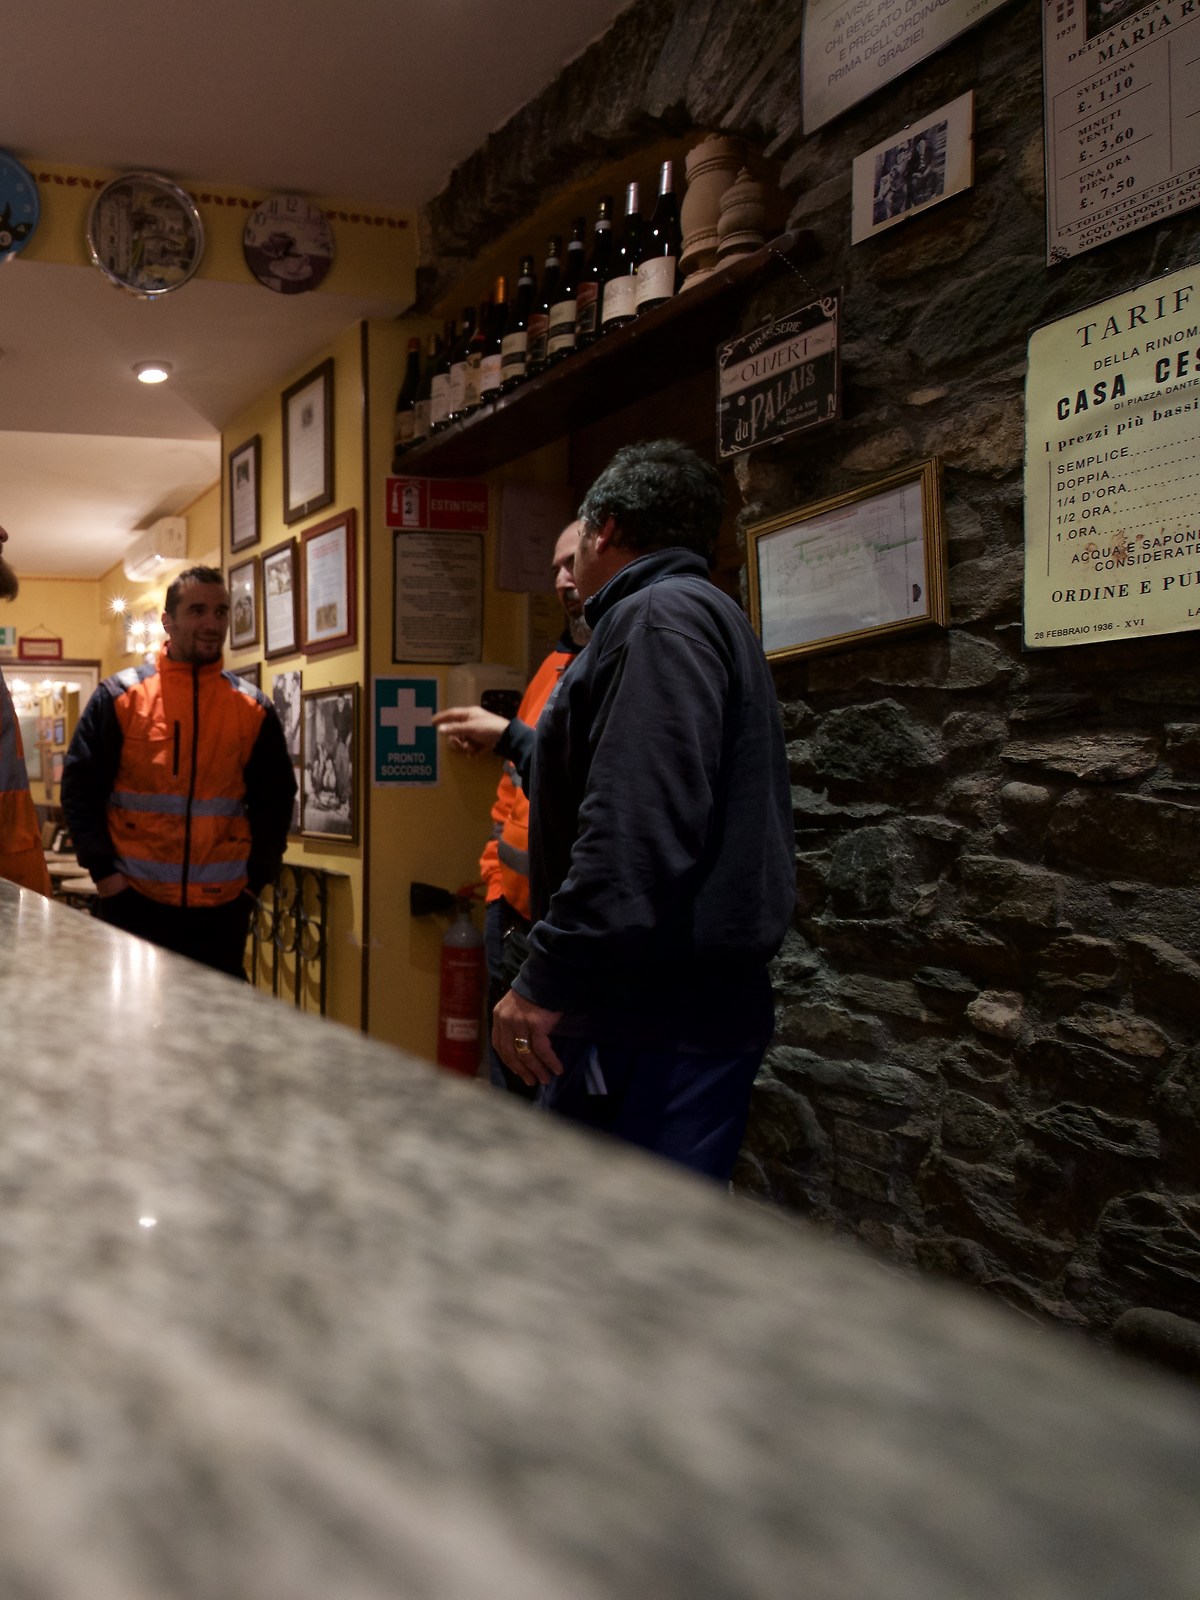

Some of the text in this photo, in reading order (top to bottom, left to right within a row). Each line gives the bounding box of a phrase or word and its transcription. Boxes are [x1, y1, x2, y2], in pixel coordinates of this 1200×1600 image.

[826, 33, 844, 54] CHI
[846, 10, 875, 38] BEVE
[840, 48, 847, 60] E
[849, 8, 901, 54] PREGATO
[878, 27, 924, 67] GRAZIE!
[1068, 4, 1161, 62] DELLA CASA
[1098, 14, 1171, 65] MARIA
[828, 56, 861, 86] PRIMA
[1077, 62, 1135, 98] SVELTINA
[1100, 76, 1133, 103] 1,10
[1078, 124, 1114, 146] VENTI
[1079, 109, 1121, 137] MINUTI
[1100, 127, 1134, 153] 3,60
[1080, 154, 1131, 184] UNA ORA
[1080, 173, 1114, 194] PIENA
[1100, 176, 1135, 200] 7,50
[1058, 227, 1072, 238] LA
[1076, 197, 1137, 230] TOILETTE
[1159, 177, 1183, 193] SUL
[1080, 220, 1116, 241] ACQUA
[1119, 199, 1164, 222] SAPONE
[1079, 230, 1112, 249] SONO
[1116, 203, 1173, 233] OFFERTI
[1076, 285, 1194, 348] TARIF
[741, 337, 812, 381] OUVERT
[1094, 325, 1200, 371] DELLA RINOM
[750, 363, 816, 443] PALAIS
[1057, 374, 1126, 421] CASA
[1114, 377, 1200, 411] DI PIAZZA DANTE
[1045, 397, 1200, 454] I prezzi più bassi
[1057, 446, 1129, 475] SEMPLICE
[1057, 470, 1110, 492] DOPPIA
[1057, 484, 1127, 508] 1/4 D'ORA
[431, 499, 487, 513] ESTINTORE
[1056, 505, 1111, 525] 1/2 ORA
[1056, 525, 1098, 542] 1 ORA
[1071, 528, 1200, 563] ACQUA E SAPON
[1052, 583, 1130, 603] ORDINE
[1140, 580, 1152, 594] E
[1034, 631, 1044, 640] 28
[1046, 625, 1090, 638] FEBBRAIO
[1093, 622, 1113, 632] 1936
[1125, 618, 1145, 628] XVI
[380, 765, 433, 776] SOCCORSO
[387, 752, 426, 763] PRONTO
